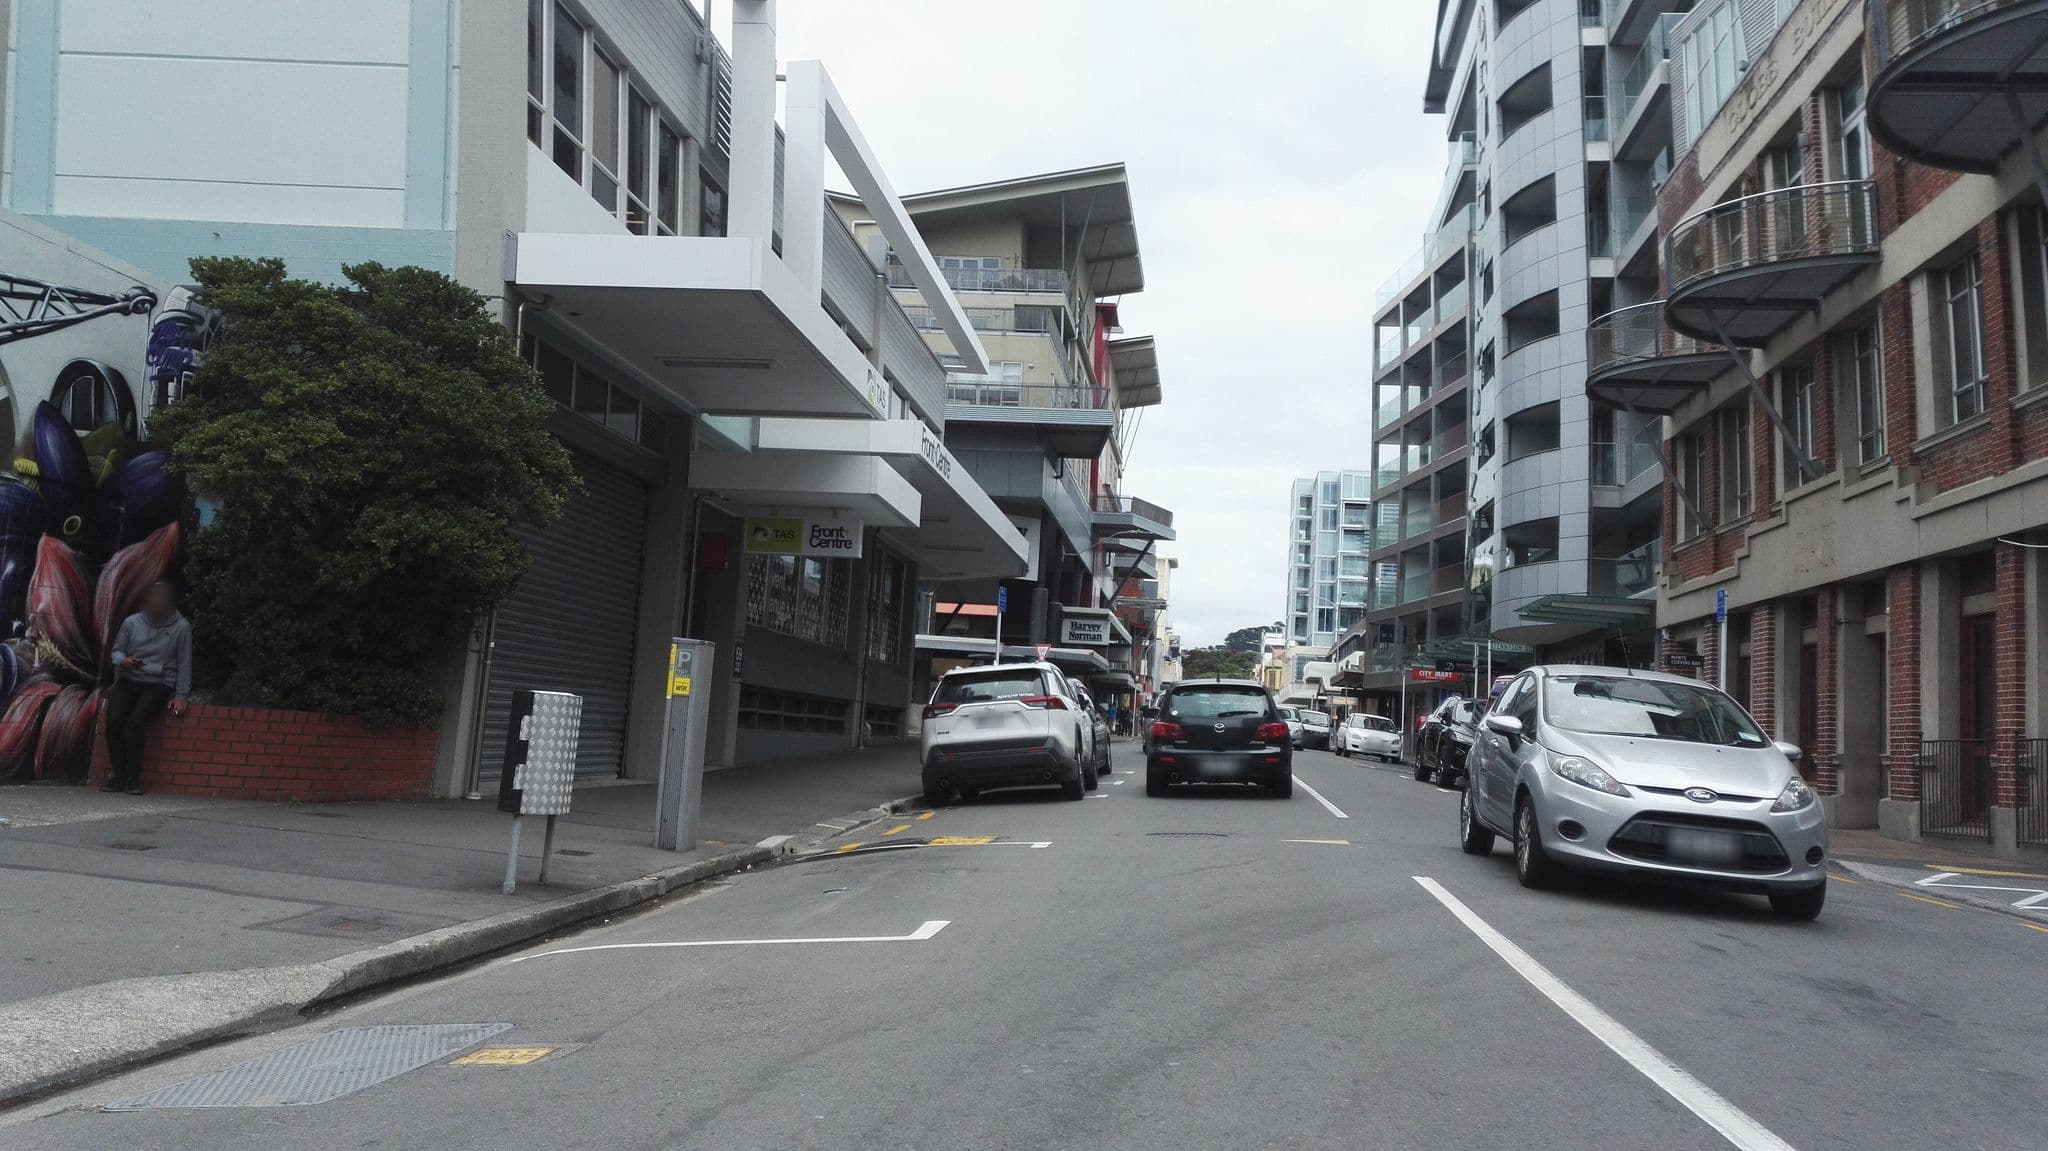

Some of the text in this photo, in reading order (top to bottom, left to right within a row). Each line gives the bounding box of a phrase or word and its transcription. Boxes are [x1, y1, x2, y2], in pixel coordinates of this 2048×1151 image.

[876, 383, 886, 410] TAS
[921, 426, 952, 480] Front Centre
[774, 529, 794, 539] TAS
[811, 525, 845, 539] Front
[809, 536, 853, 549] Centre
[1071, 621, 1102, 632] Harvey
[1068, 631, 1102, 640] Norman
[678, 651, 692, 667] P
[1692, 790, 1710, 799] Ford
